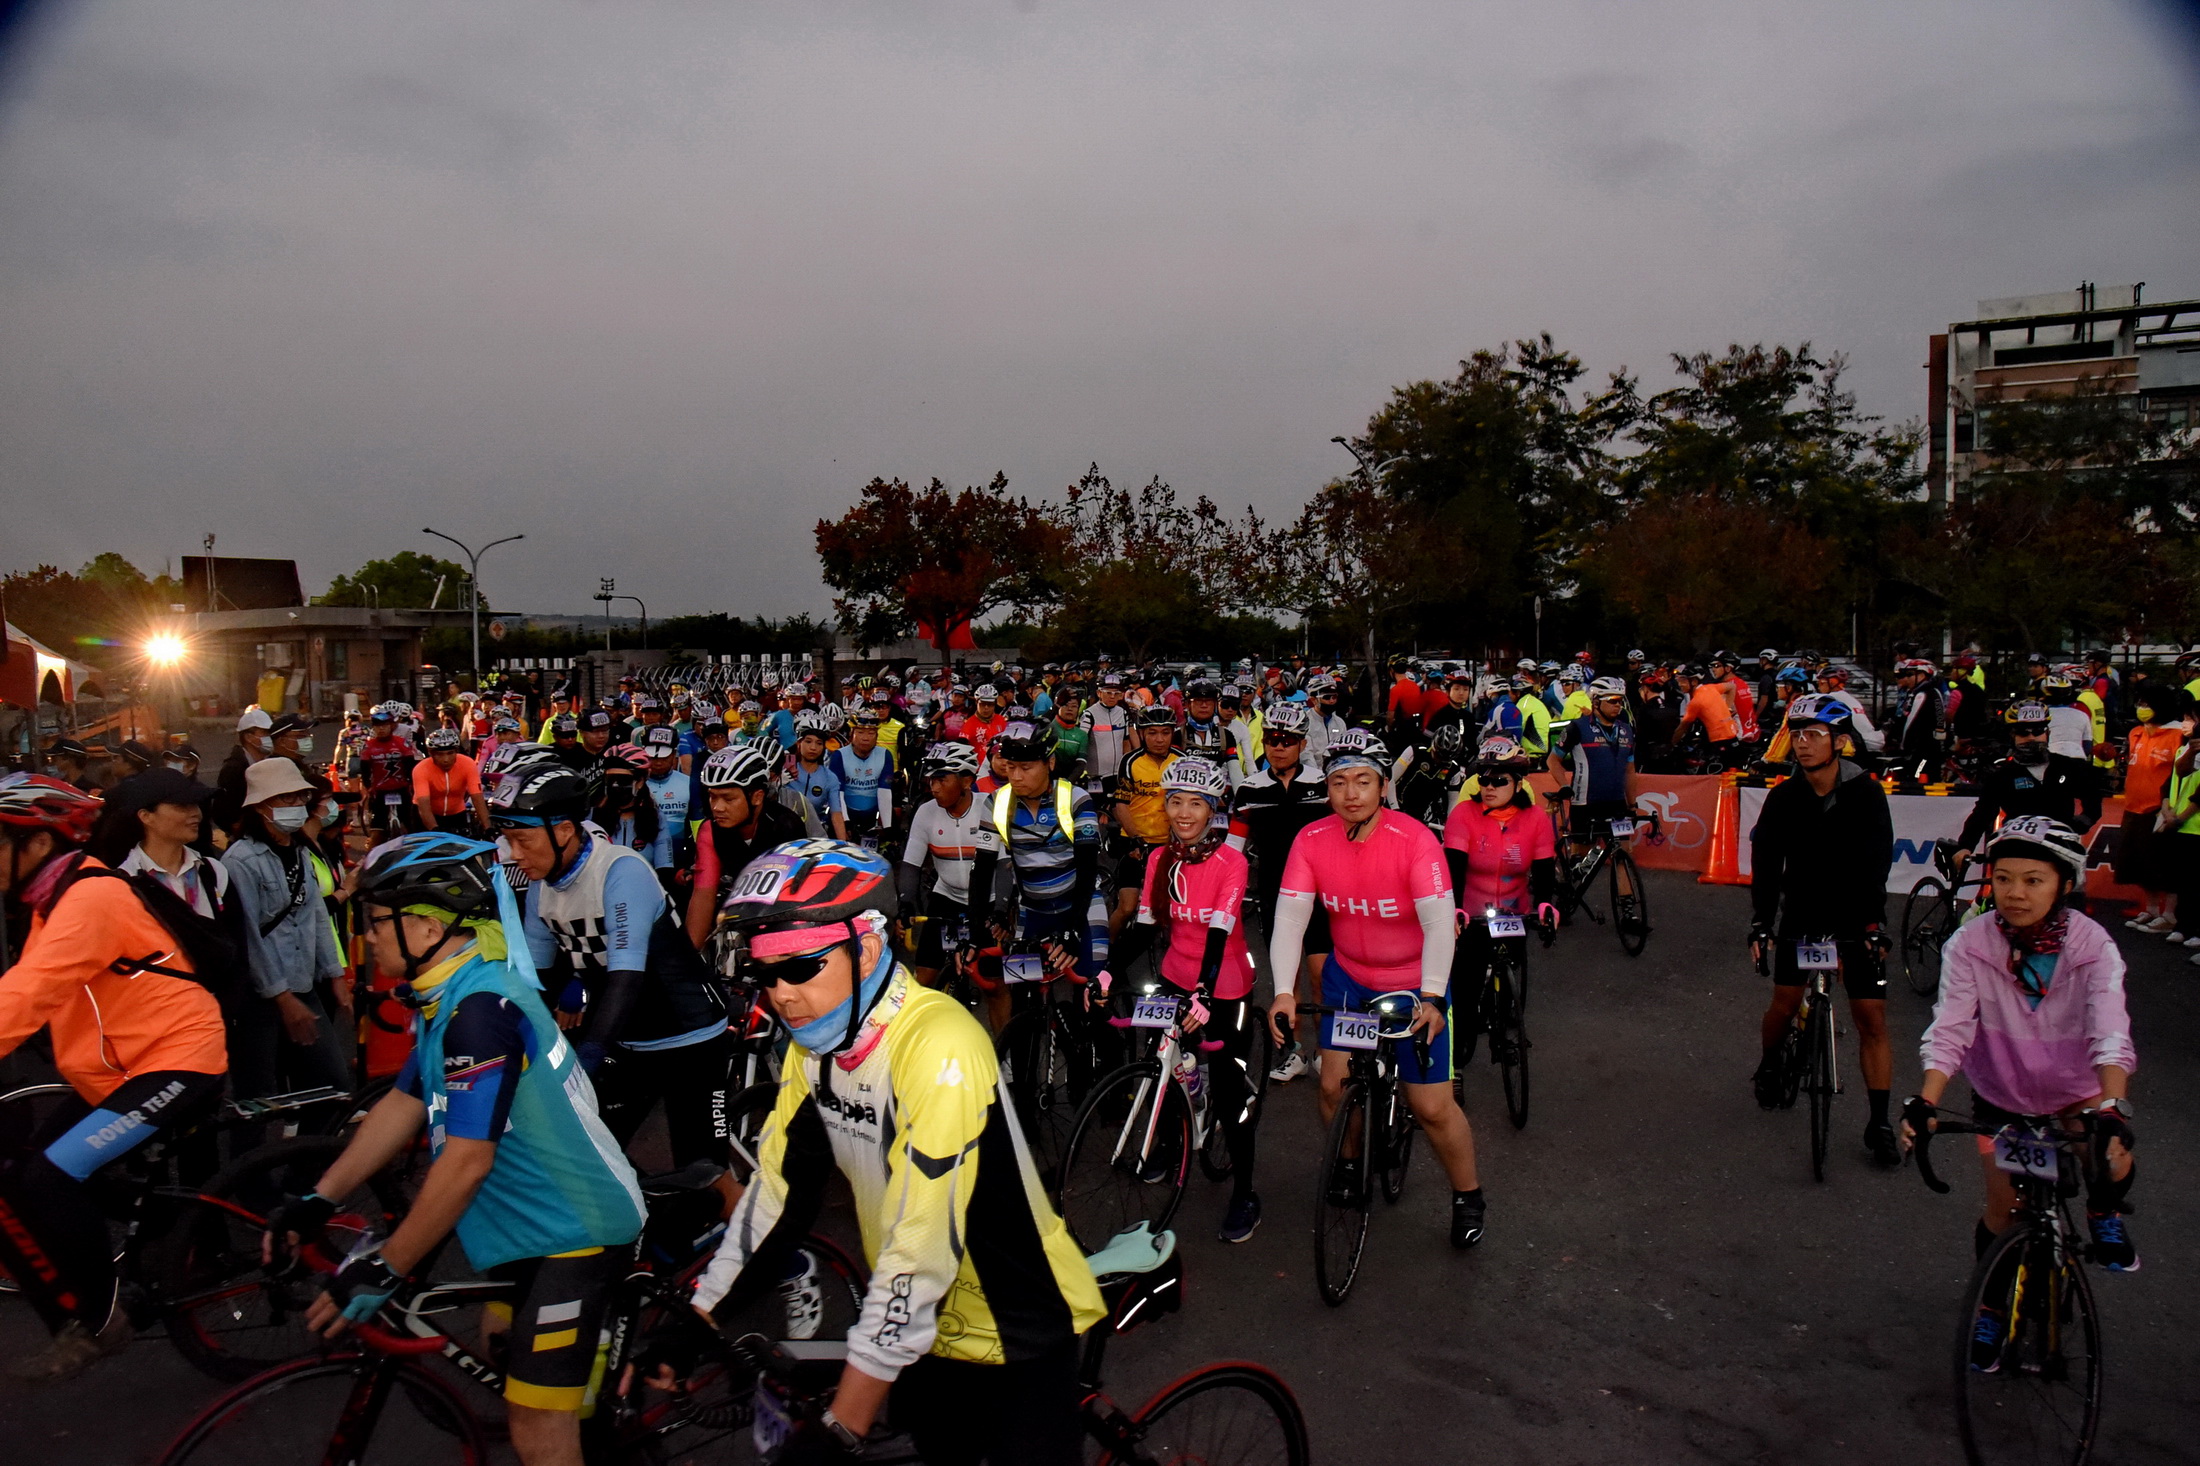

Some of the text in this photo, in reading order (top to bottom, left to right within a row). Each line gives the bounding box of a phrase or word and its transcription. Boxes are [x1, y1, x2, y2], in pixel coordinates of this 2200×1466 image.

[1792, 703, 1808, 714] 151
[654, 731, 669, 741] 754
[1176, 769, 1206, 786] 1435
[1616, 822, 1631, 832] 175
[864, 840, 877, 849] 745
[1494, 920, 1520, 932] 725
[1803, 950, 1829, 963] 151
[1018, 962, 1026, 975] 1
[1136, 1005, 1176, 1020] 1435
[1335, 1021, 1378, 1040] 1406
[84, 1079, 188, 1150] ROVER TEAM
[711, 1089, 728, 1139] RAPHA
[2003, 1142, 2047, 1168] 238
